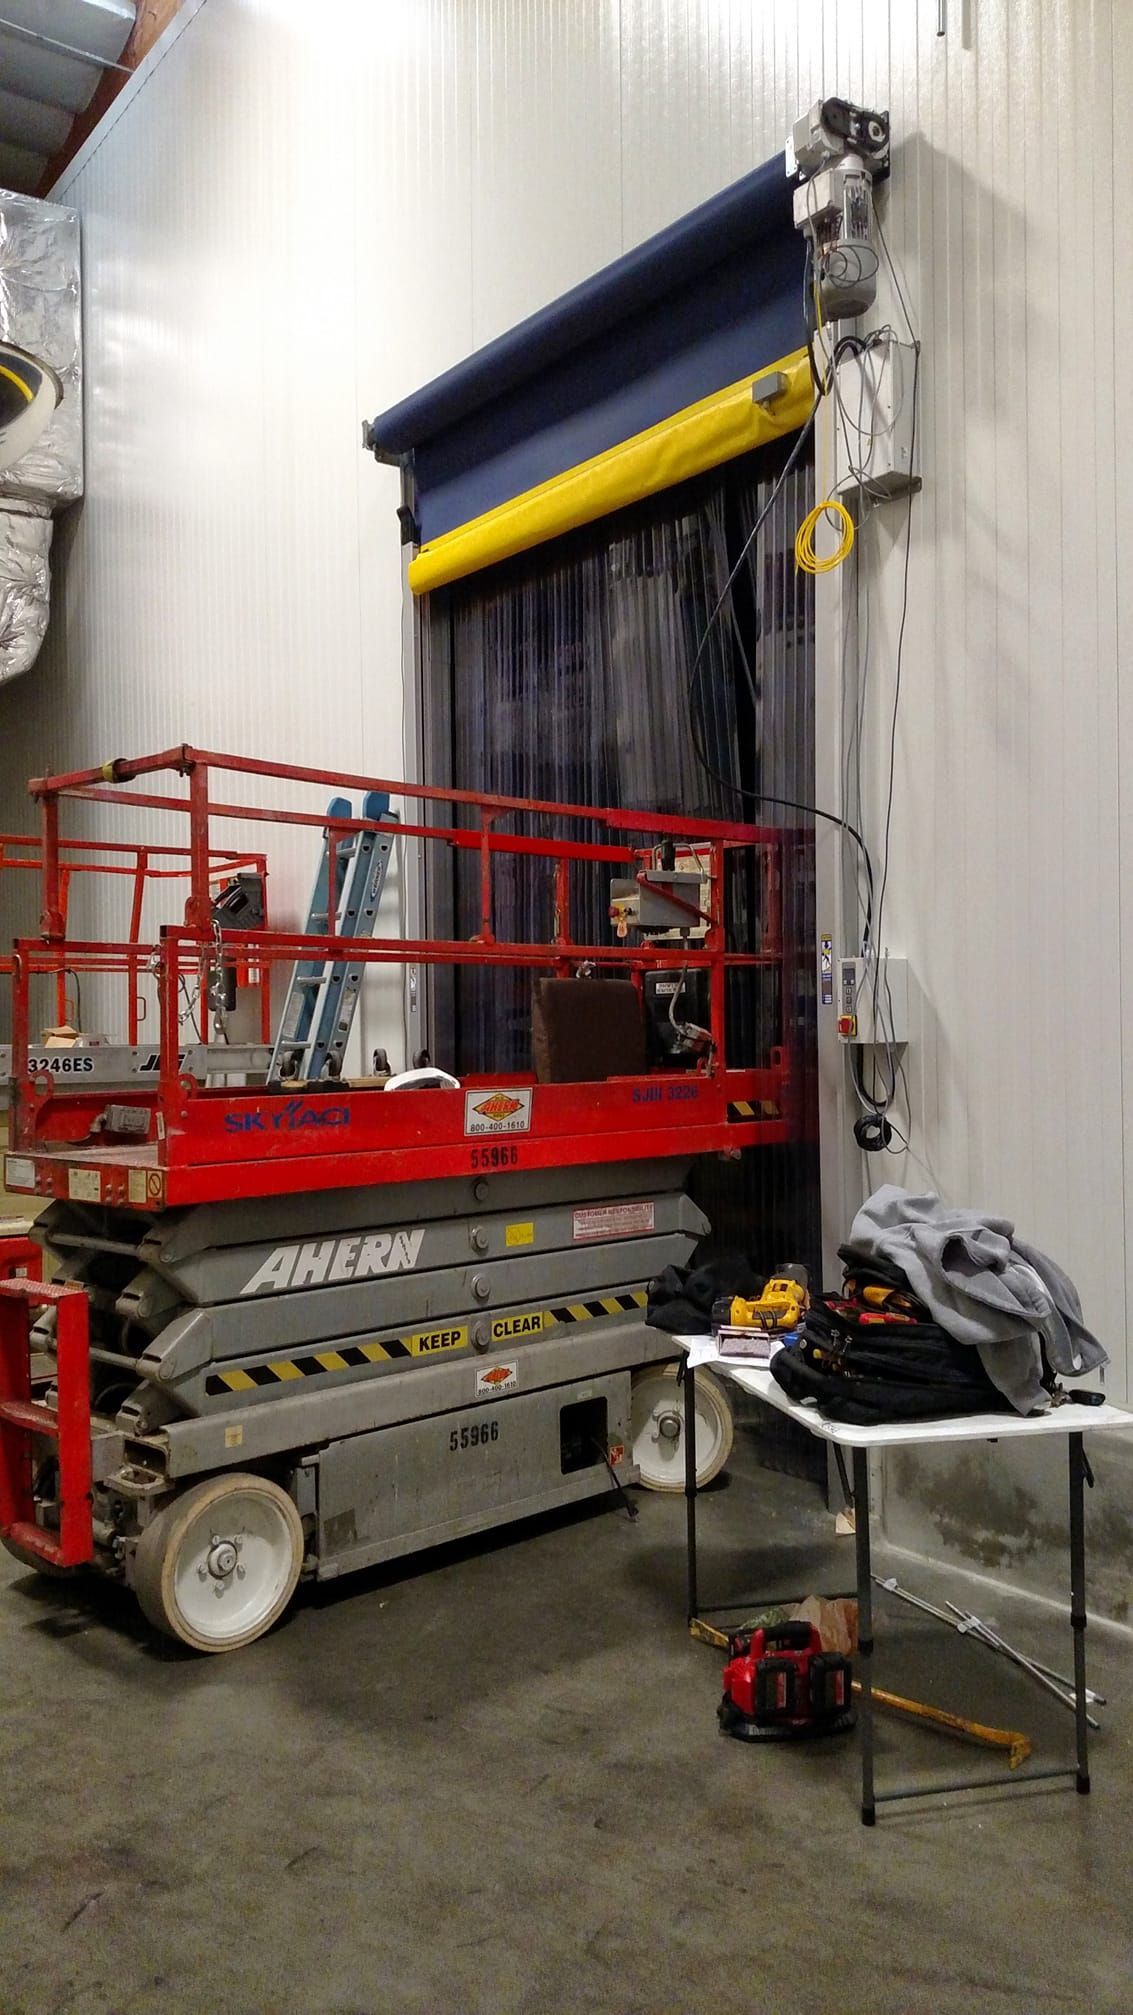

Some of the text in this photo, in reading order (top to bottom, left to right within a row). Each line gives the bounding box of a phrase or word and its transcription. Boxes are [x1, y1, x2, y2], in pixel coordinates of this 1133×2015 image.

[28, 1057, 93, 1073] 3246ES
[470, 1120, 525, 1132] 800-400-1610
[471, 1146, 518, 1168] 55966
[240, 1229, 425, 1295] AHERN
[419, 1316, 541, 1352] KEEP CLEAR
[450, 1421, 499, 1452] 55966
